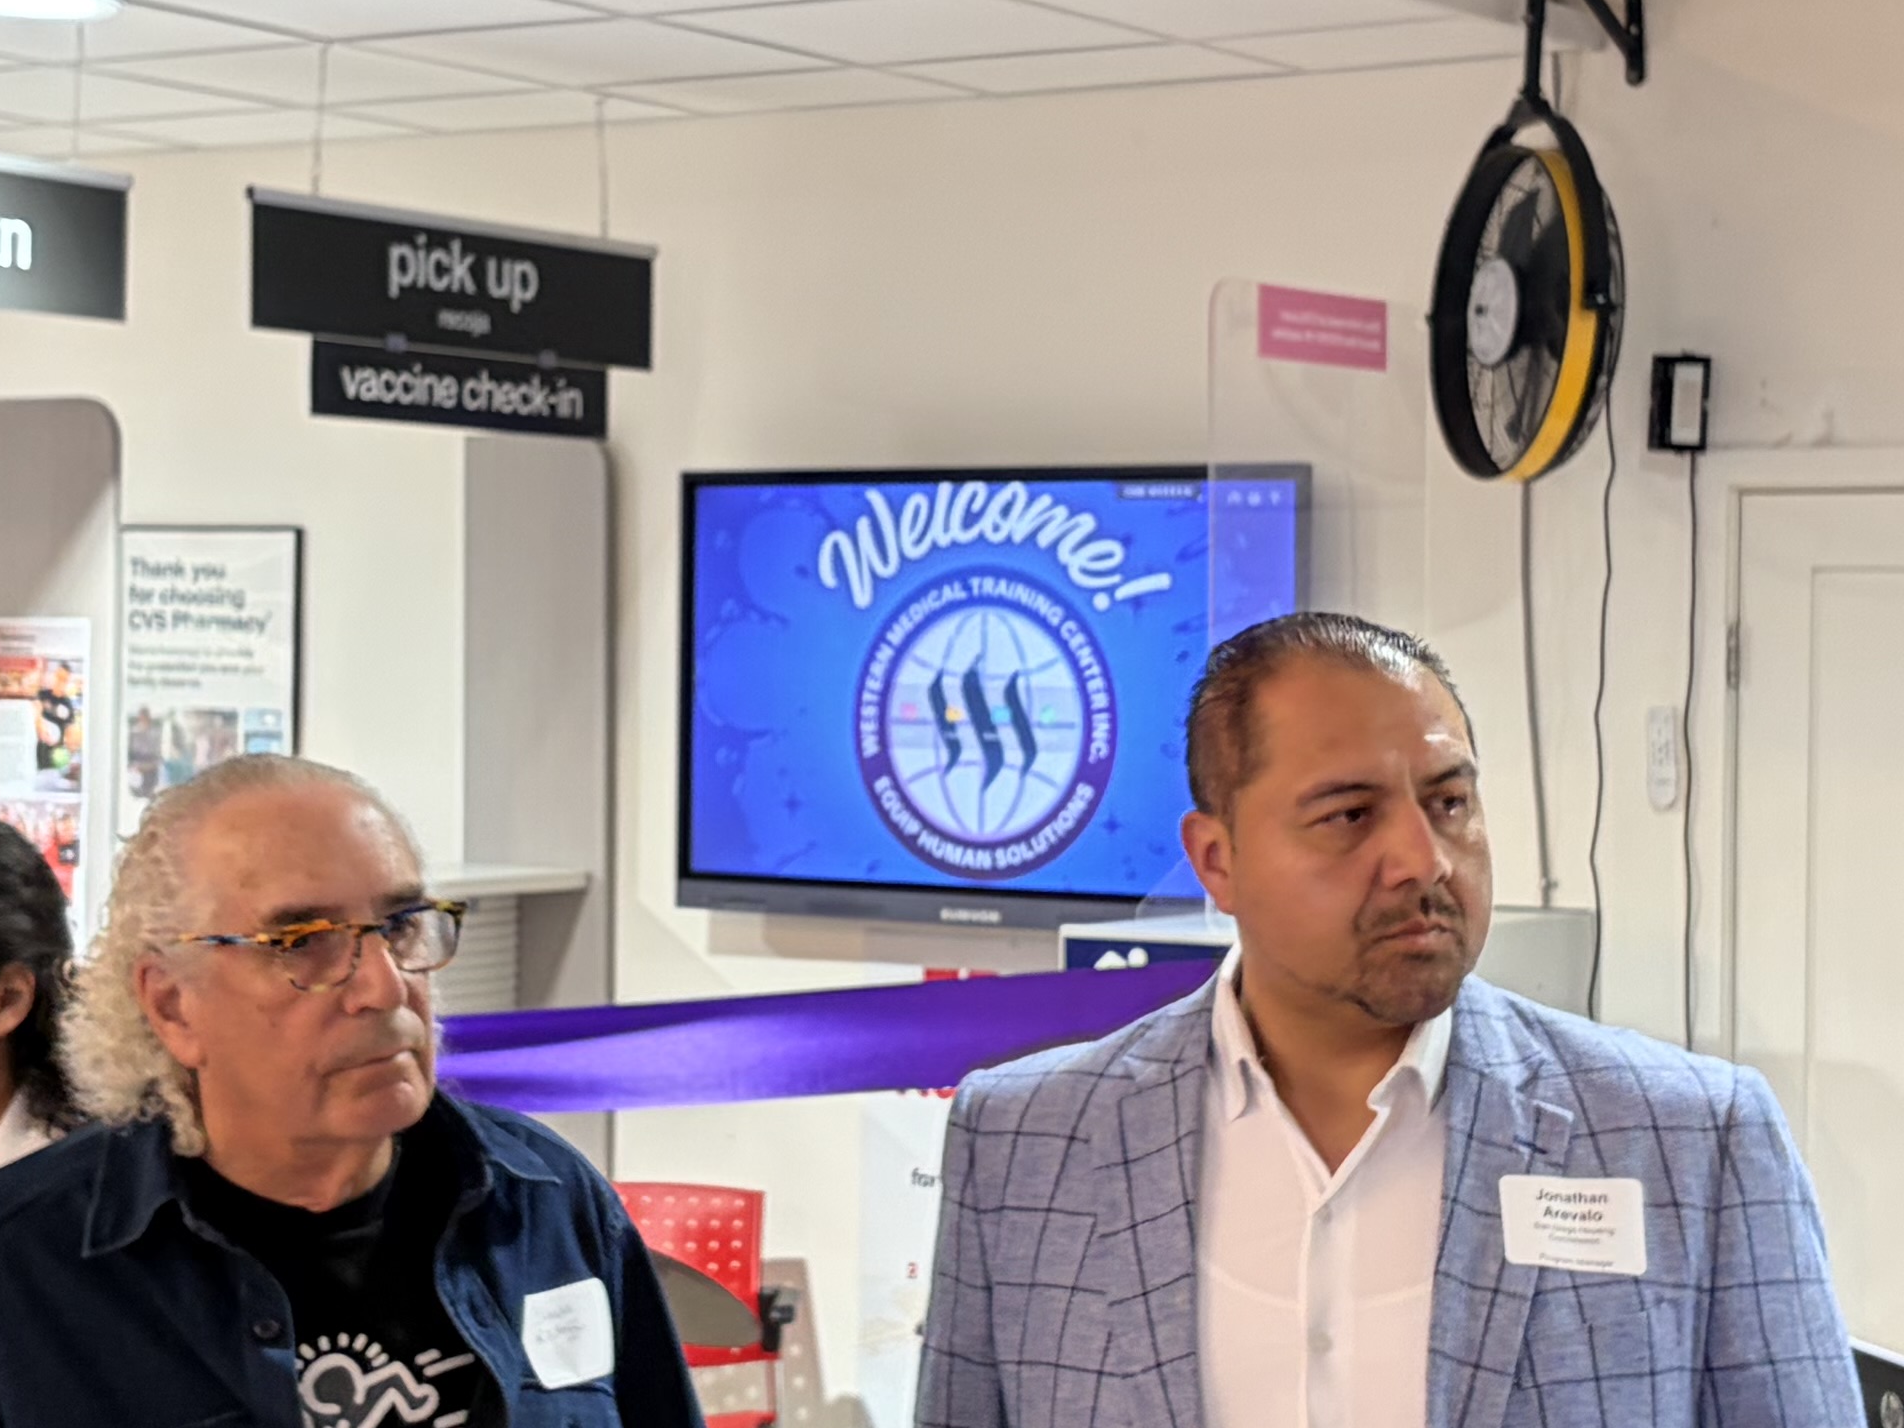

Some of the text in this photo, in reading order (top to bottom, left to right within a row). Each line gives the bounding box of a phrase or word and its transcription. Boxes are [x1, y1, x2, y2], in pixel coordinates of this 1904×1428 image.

[387, 232, 539, 313] pick up
[339, 361, 585, 420] vaccine check-in
[129, 555, 227, 583] Thank you
[818, 480, 1173, 609] Welcome!
[128, 609, 167, 632] CVS
[159, 586, 246, 610] choosing
[885, 580, 967, 649] MEDICAL
[968, 575, 1065, 627] TRAINING
[1060, 620, 1110, 710] CENTER
[916, 828, 993, 869] HUMAN
[993, 782, 1095, 869] SOLUTIONS
[1536, 1188, 1608, 1205] Jonathan
